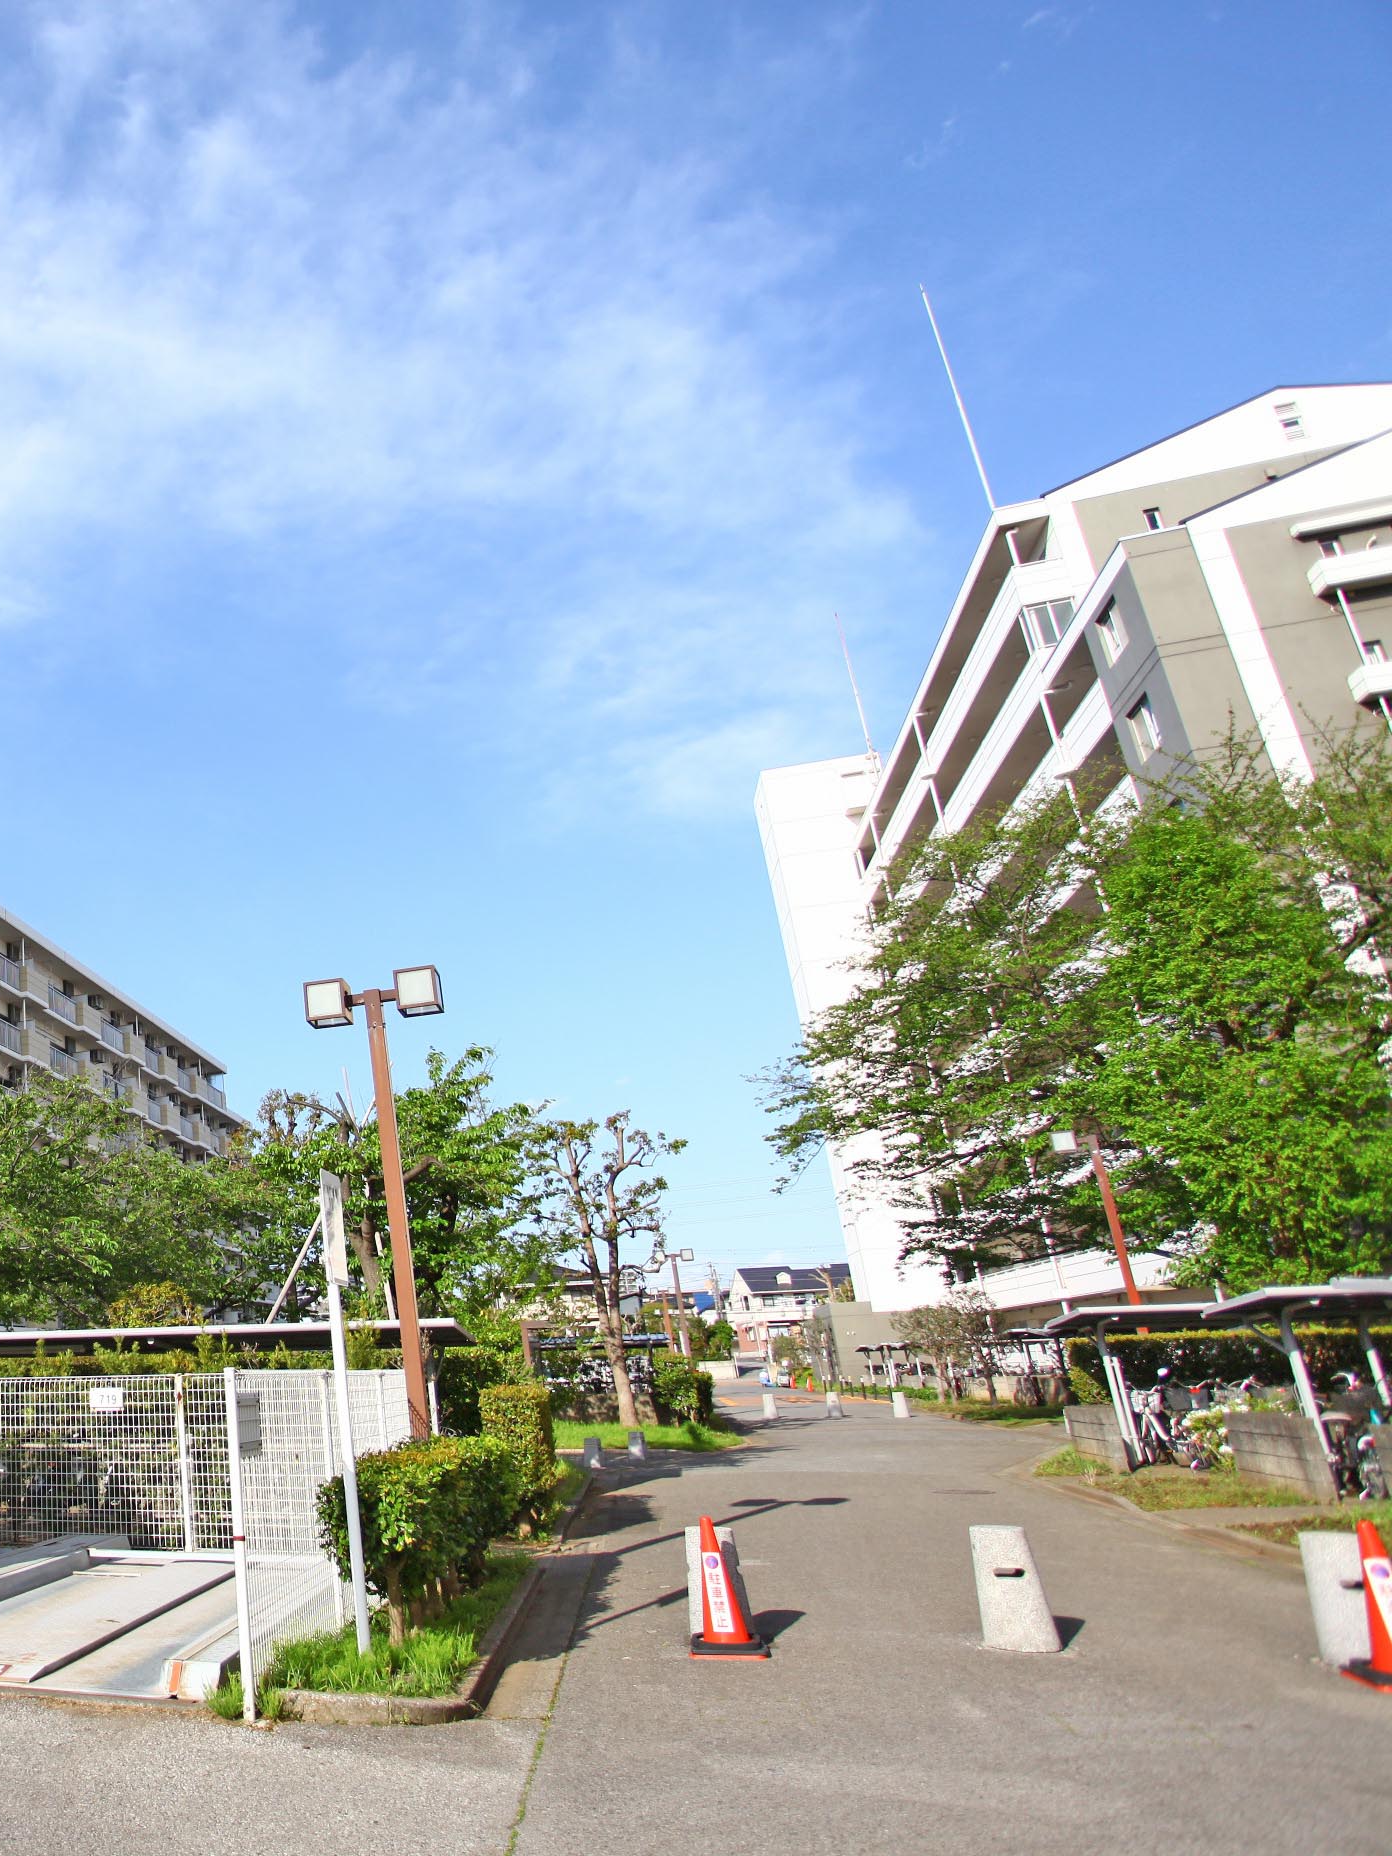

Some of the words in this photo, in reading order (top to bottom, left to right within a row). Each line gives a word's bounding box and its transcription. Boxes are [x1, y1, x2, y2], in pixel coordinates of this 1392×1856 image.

[99, 1394, 117, 1405] 719
[708, 1572, 729, 1628] 駐車禁止
